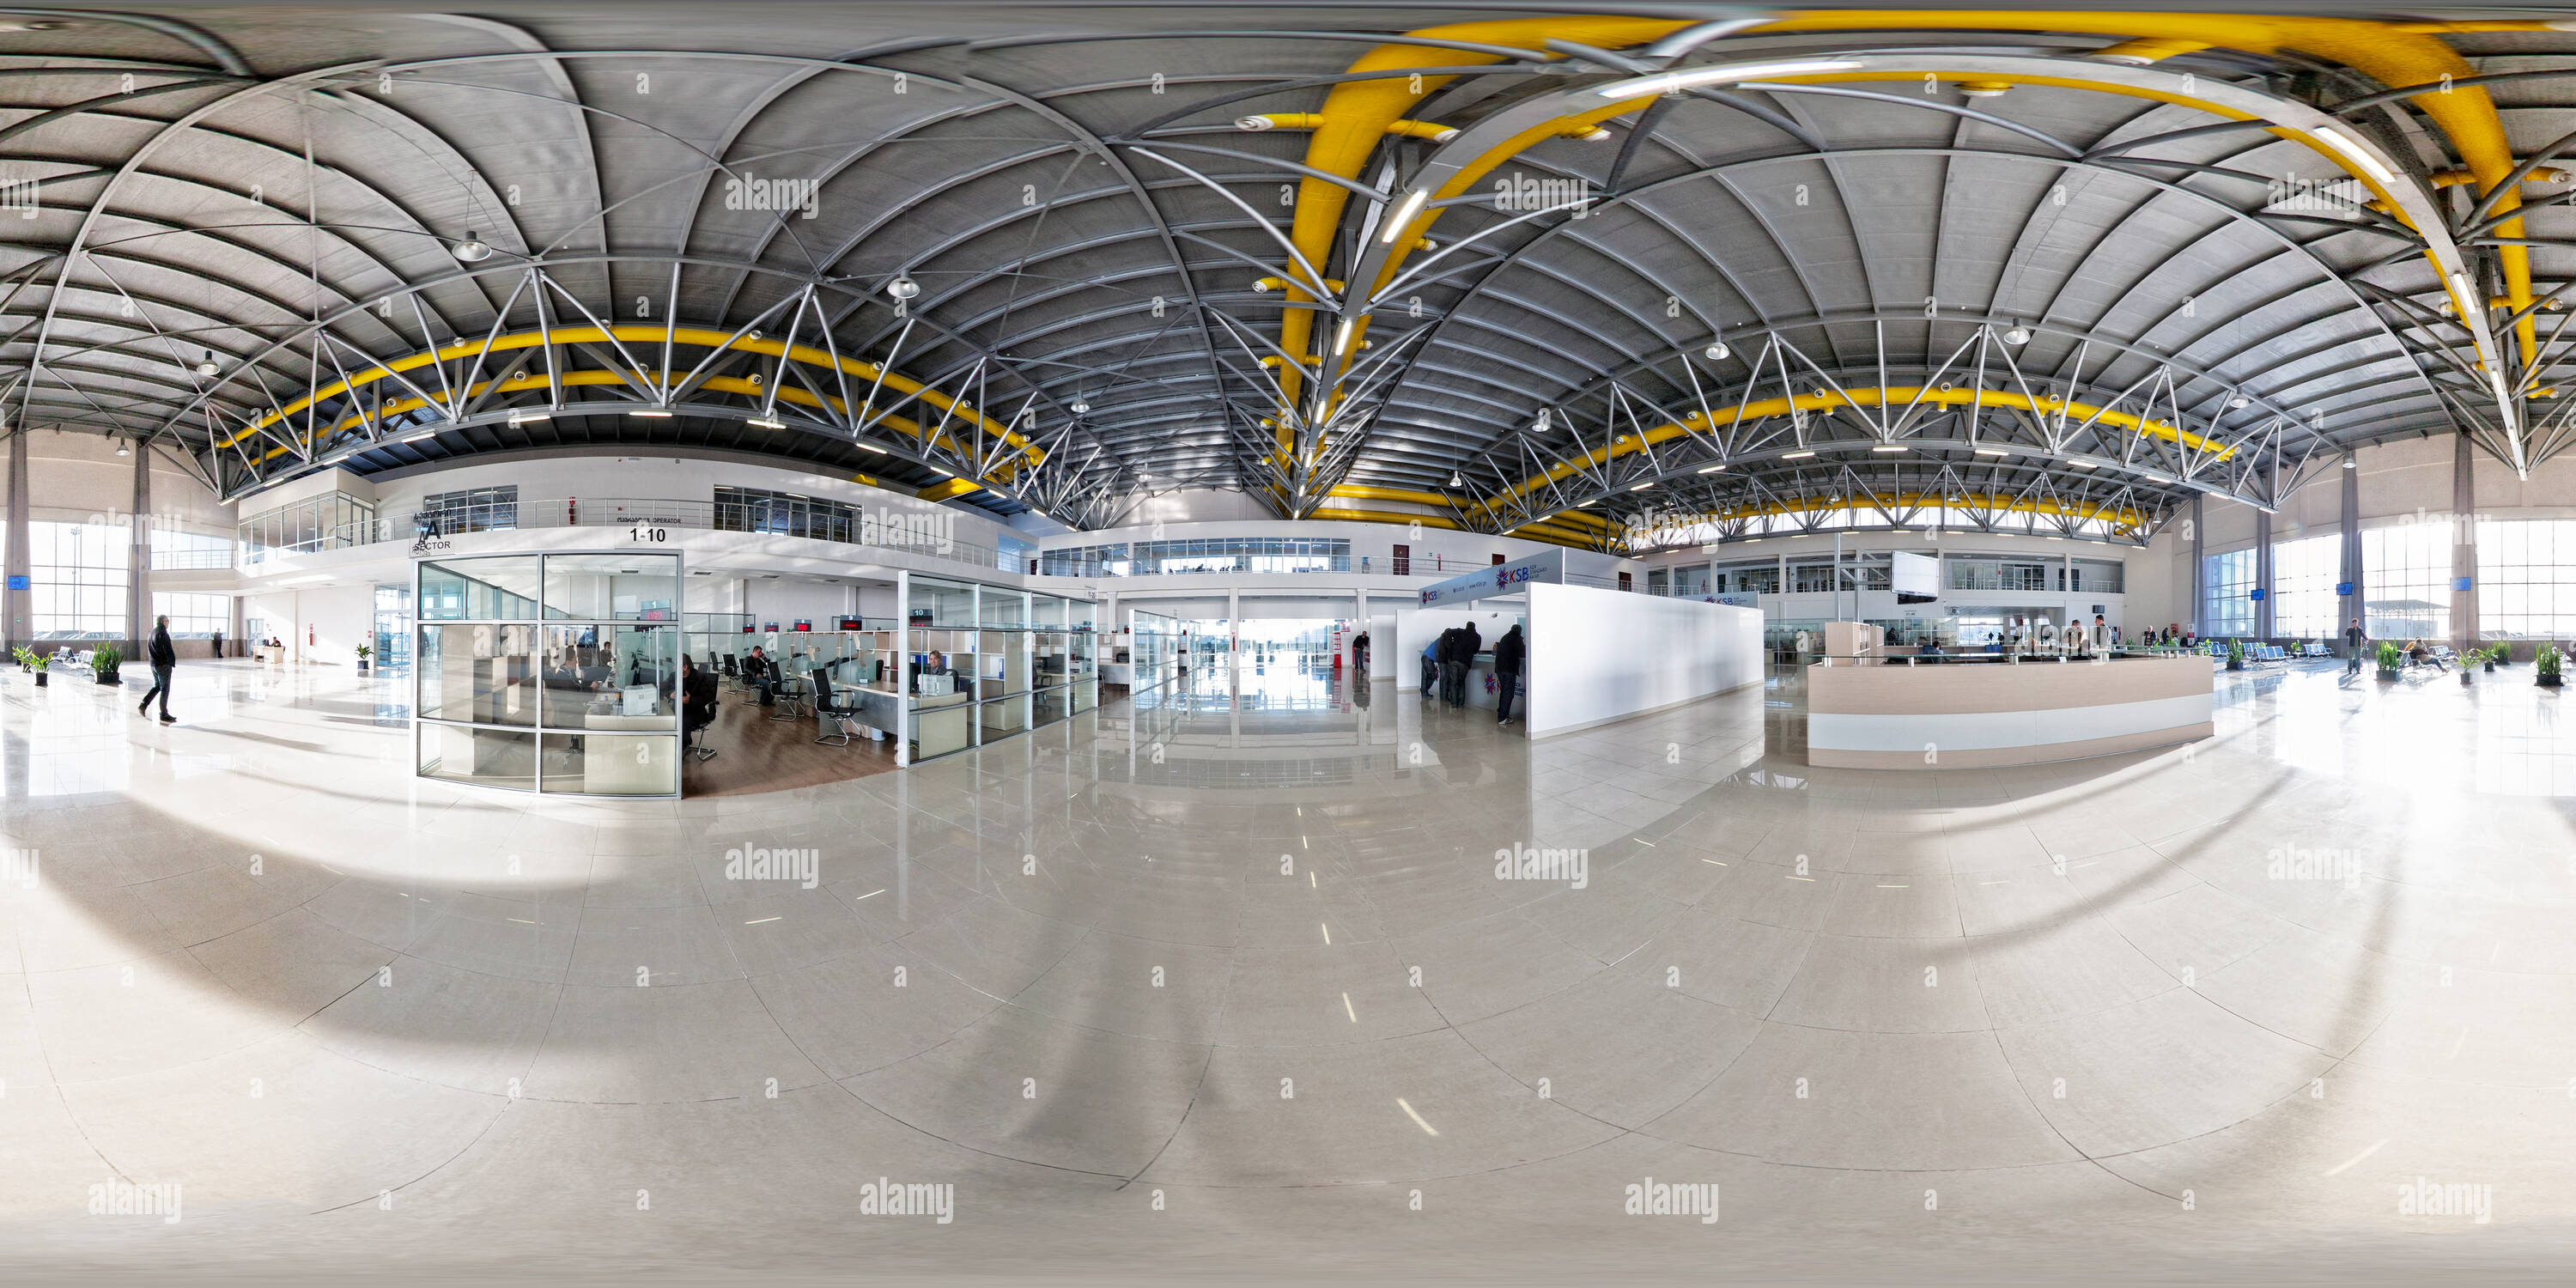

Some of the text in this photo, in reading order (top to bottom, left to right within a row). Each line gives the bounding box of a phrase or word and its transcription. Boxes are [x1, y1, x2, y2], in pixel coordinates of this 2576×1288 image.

[424, 521, 440, 539] A
[630, 527, 666, 542] 1-10
[414, 541, 451, 550] SECTOR
[1509, 567, 1529, 584] KSB
[1716, 597, 1733, 605] KSB
